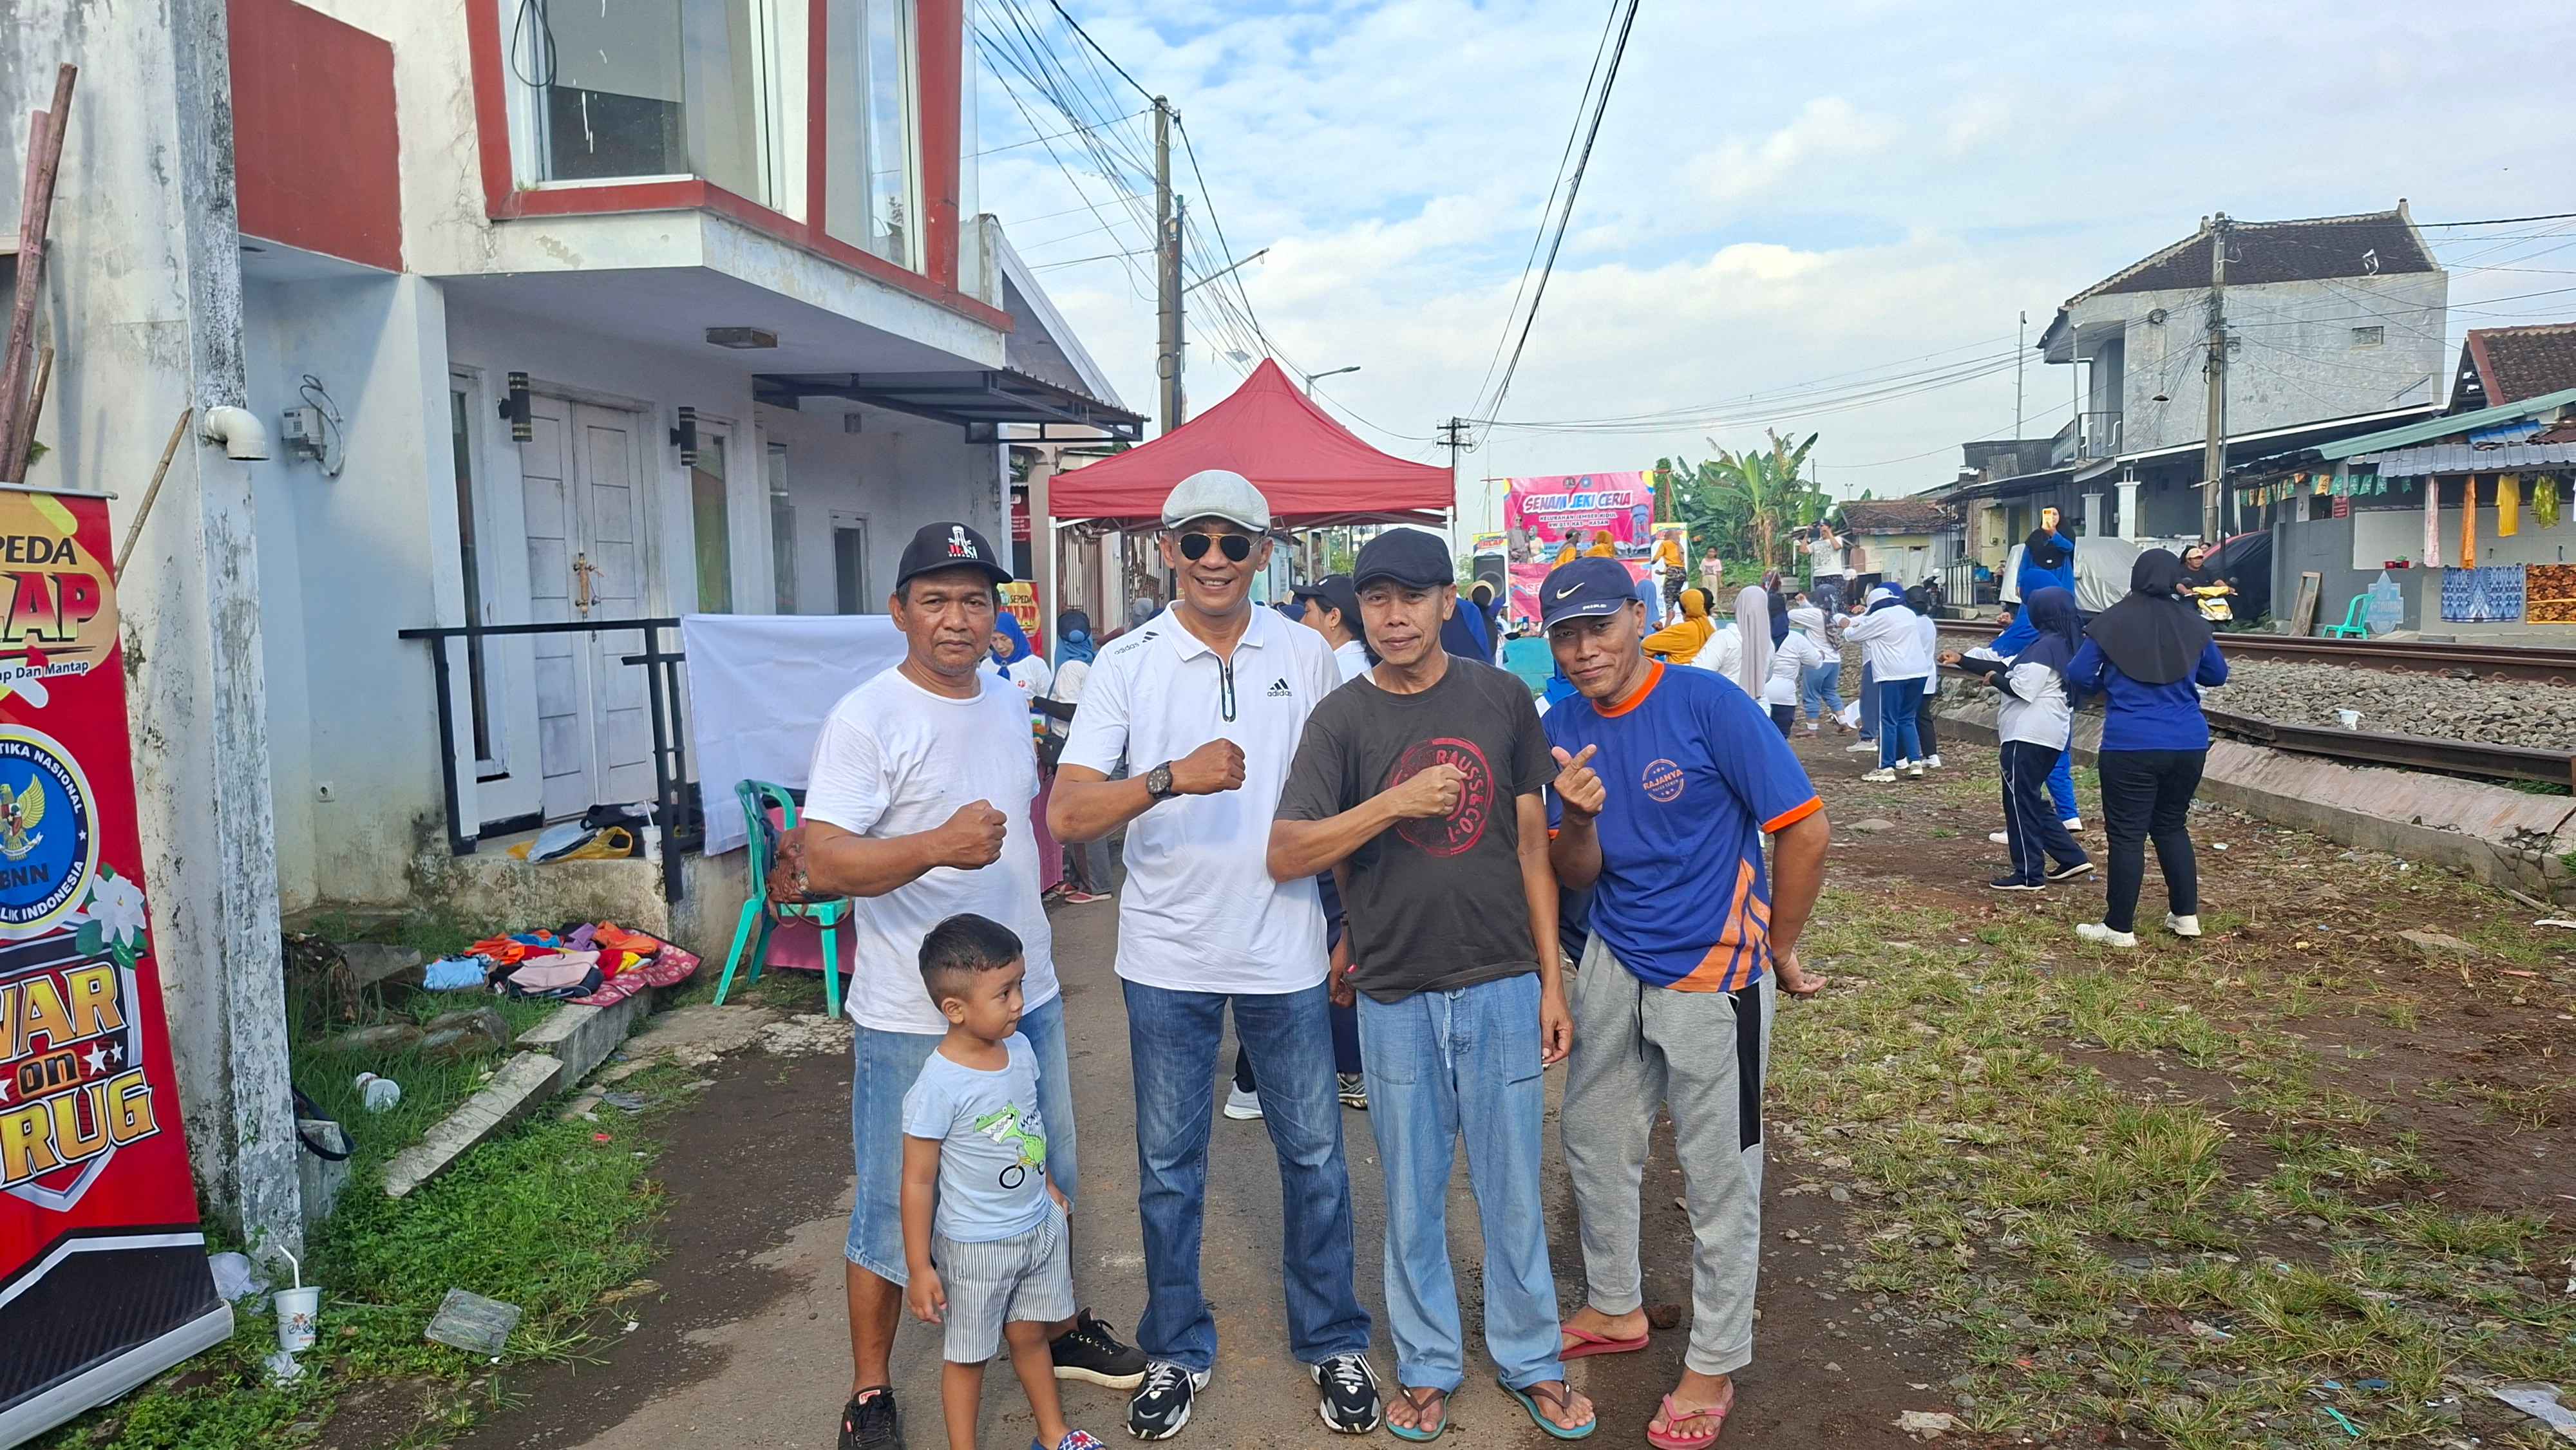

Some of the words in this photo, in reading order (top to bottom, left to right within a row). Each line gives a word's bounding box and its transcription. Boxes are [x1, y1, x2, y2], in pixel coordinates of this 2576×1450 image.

[1524, 496, 1567, 511] SENAM
[1570, 494, 1595, 509] JEKI
[1598, 492, 1631, 507] CERIA
[0, 535, 77, 565] EDA
[0, 571, 101, 642] AP
[1010, 594, 1033, 604] SEPEDA
[1114, 643, 1140, 655] adidas
[16, 666, 41, 679] Dan
[45, 661, 89, 675] Mantap
[33, 750, 82, 814] NASIONAL
[1643, 769, 1684, 791] RAJANYA
[21, 861, 85, 921] INDONESIA
[19, 1053, 78, 1096] on
[0, 1068, 160, 1187] RUG
